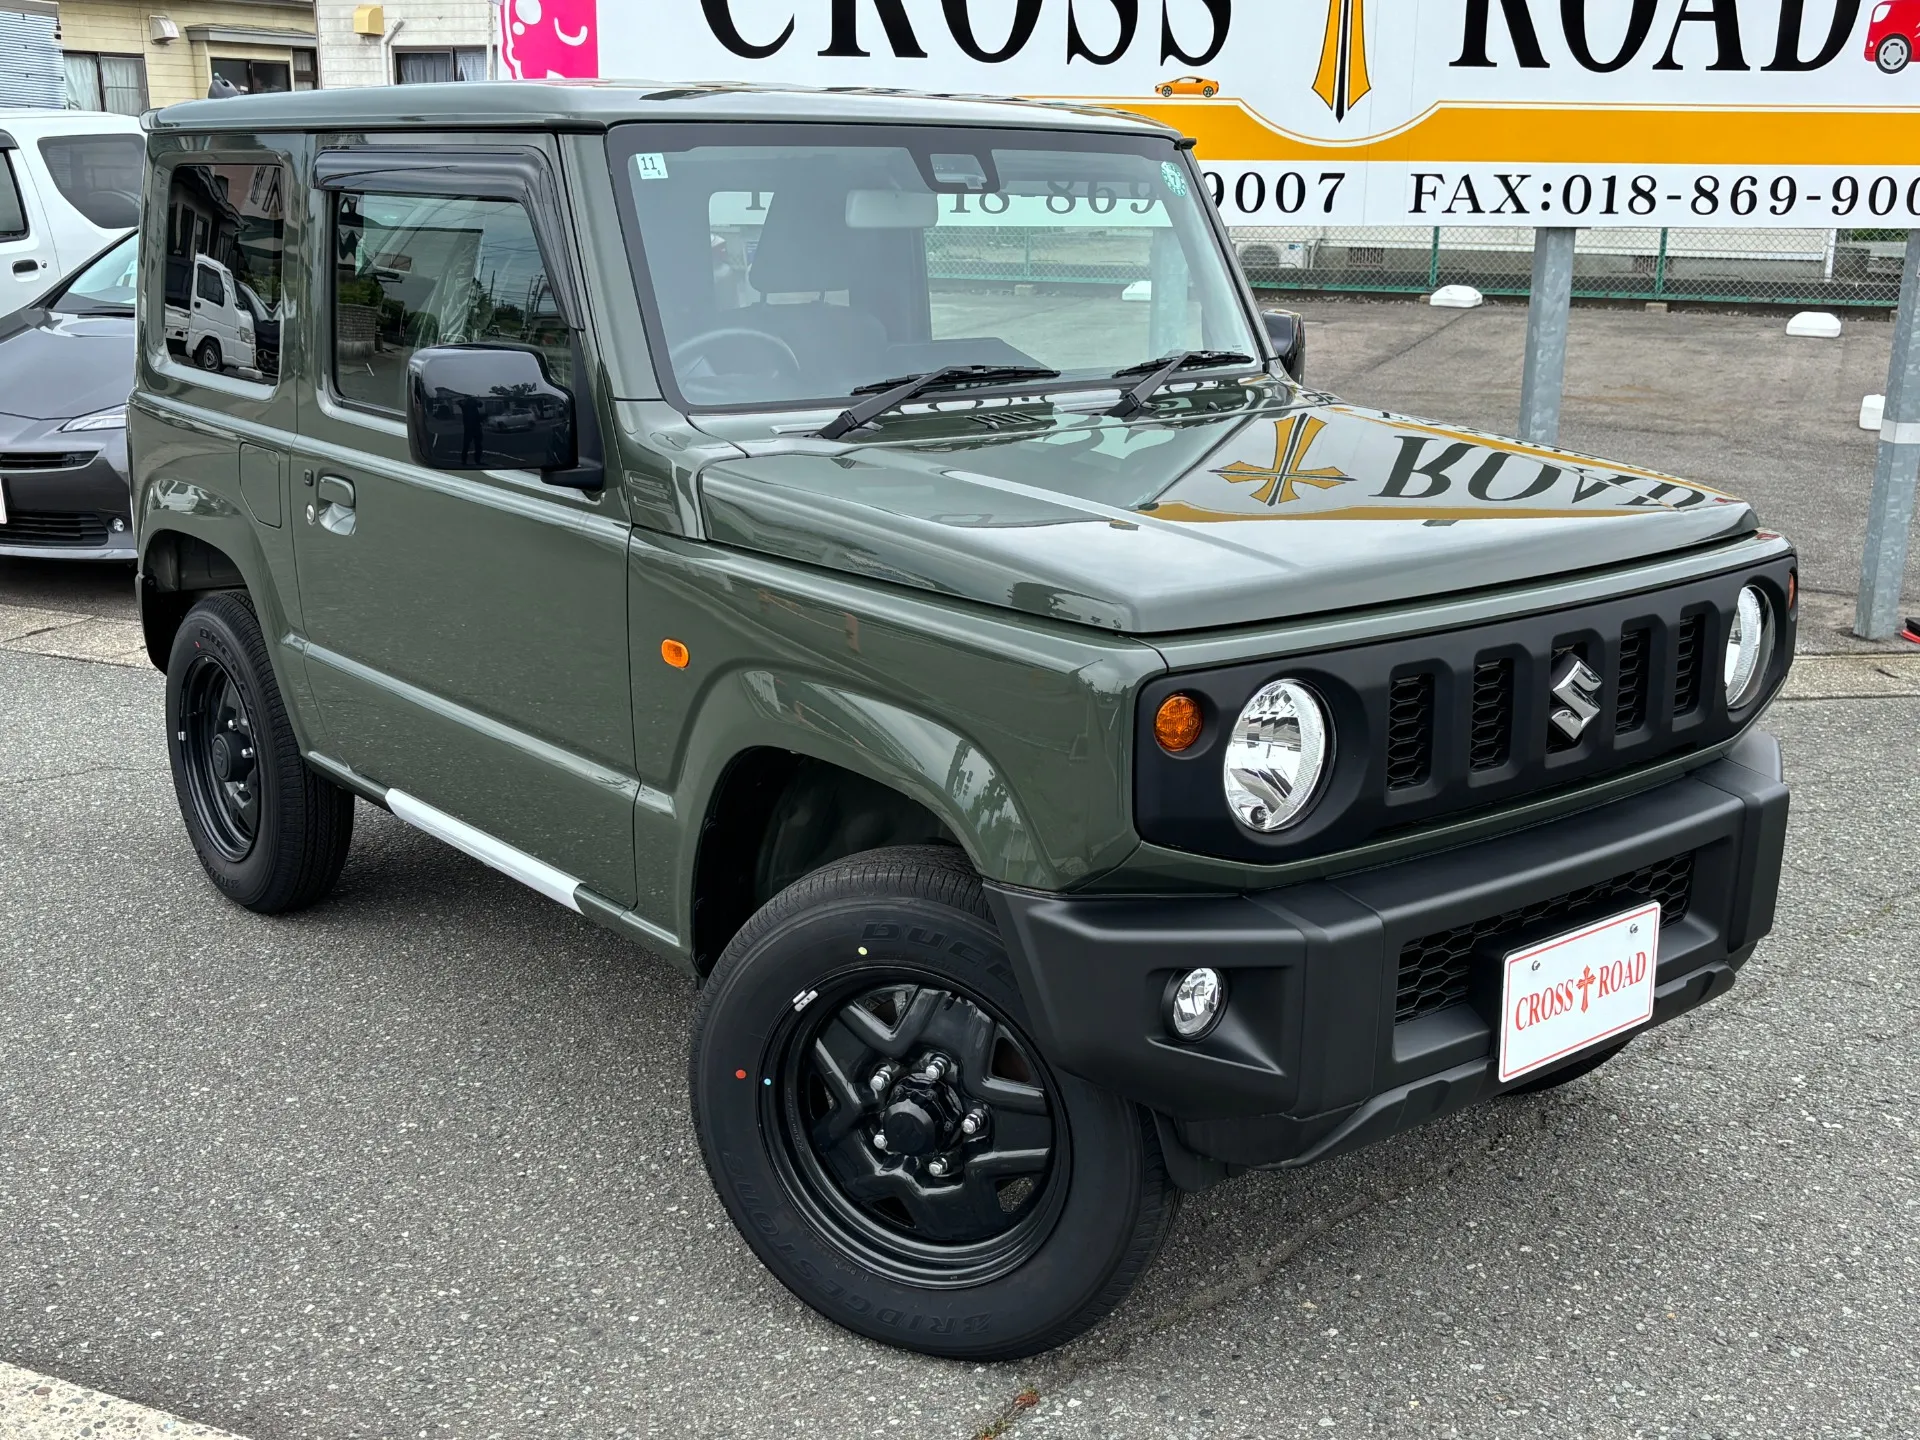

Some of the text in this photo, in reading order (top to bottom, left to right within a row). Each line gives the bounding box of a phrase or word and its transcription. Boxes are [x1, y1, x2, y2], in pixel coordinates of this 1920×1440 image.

[641, 156, 657, 170] 11
[1515, 951, 1647, 1031] CROSS ROAD
